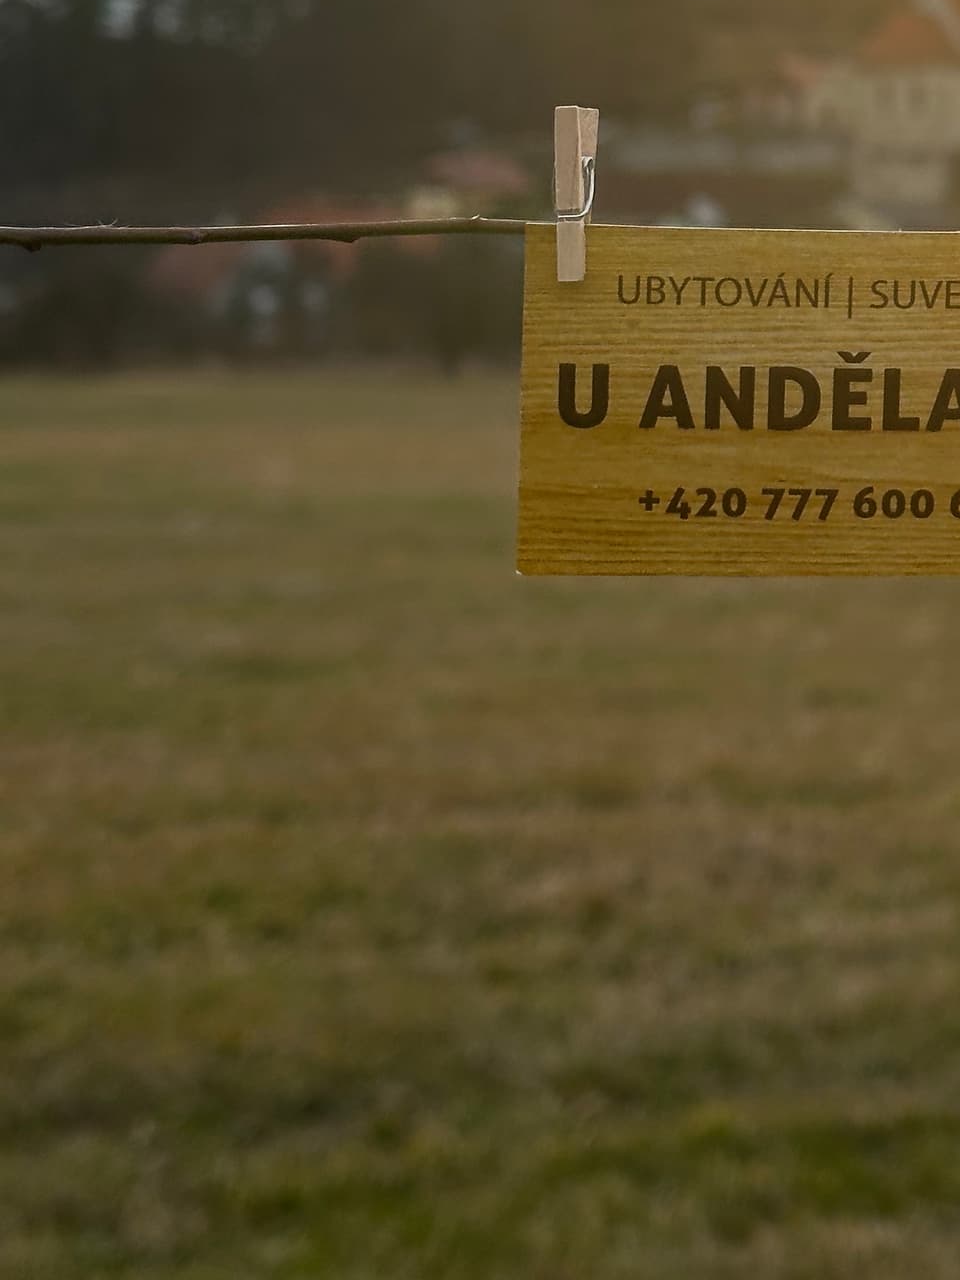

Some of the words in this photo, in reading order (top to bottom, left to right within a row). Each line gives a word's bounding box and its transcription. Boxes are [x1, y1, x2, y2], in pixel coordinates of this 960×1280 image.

[617, 272, 832, 309] UBYTOVÁNÍ
[557, 362, 610, 429] U
[638, 487, 747, 520] +420
[761, 488, 839, 521] 777
[853, 488, 935, 519] 600
